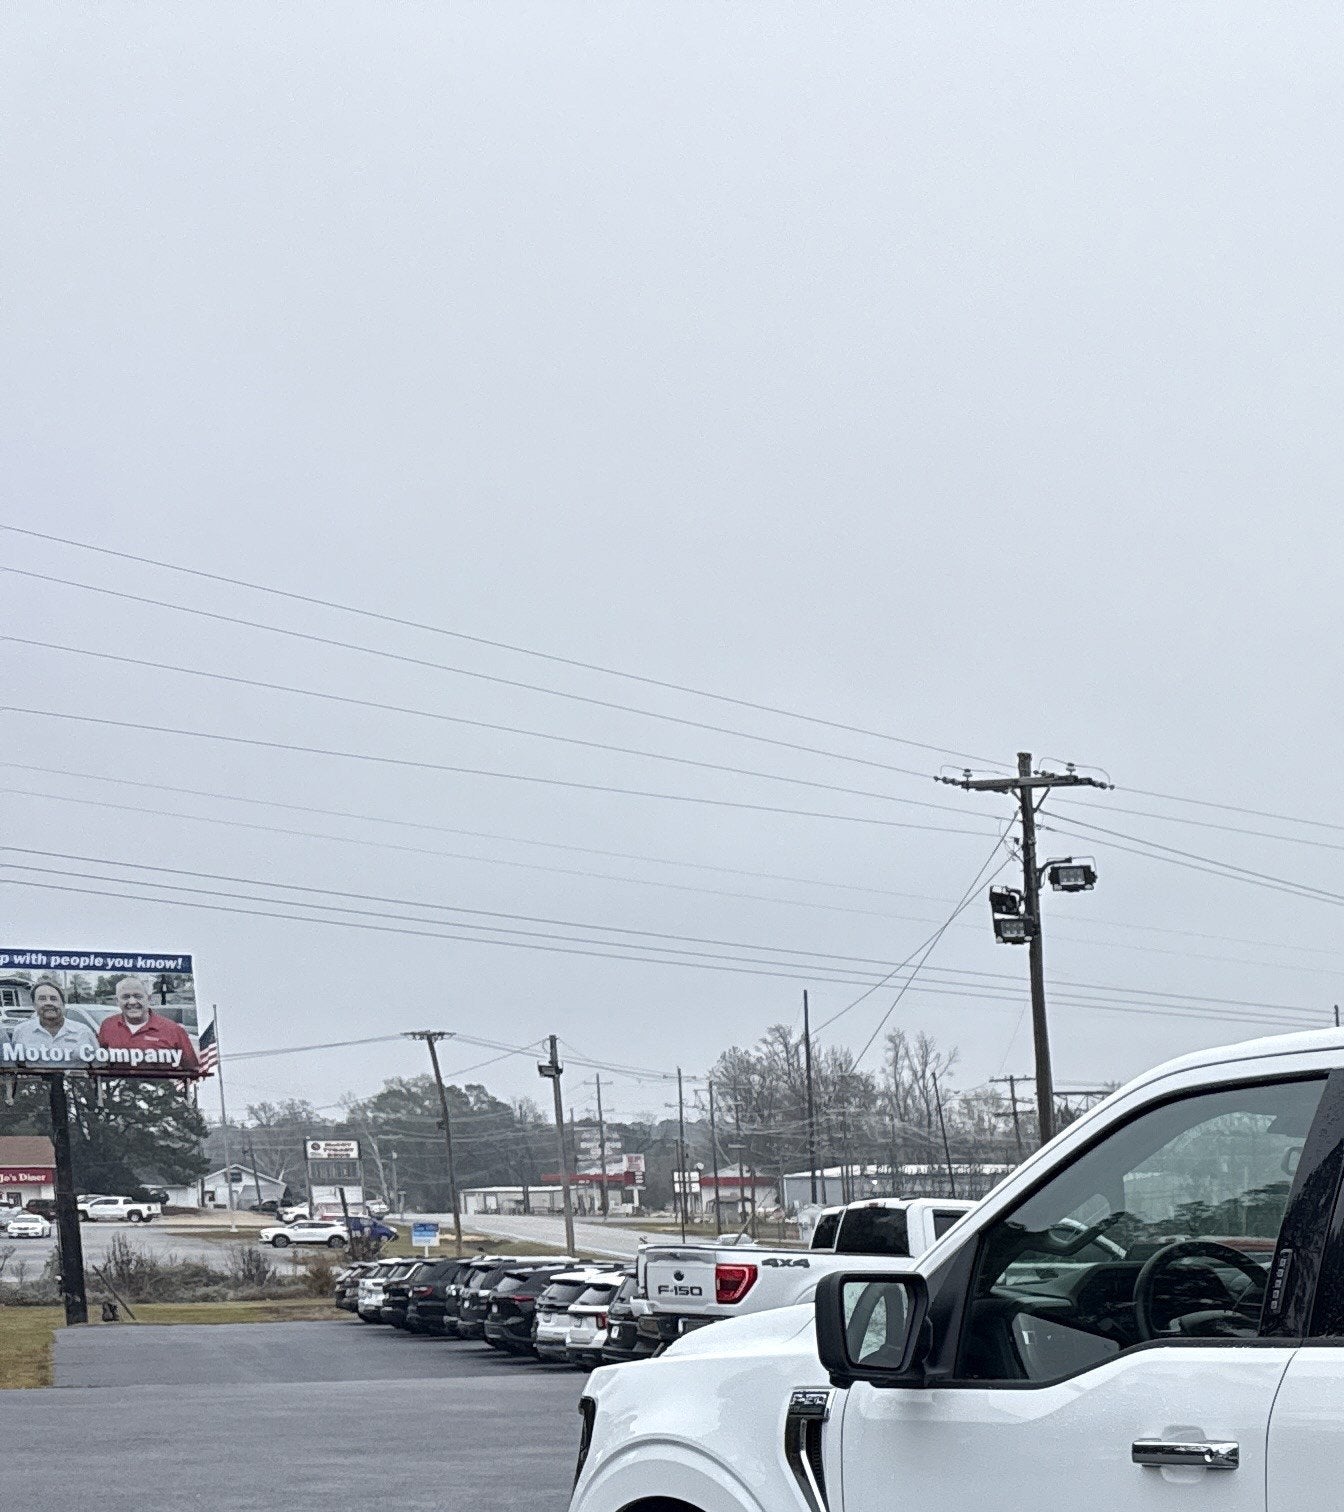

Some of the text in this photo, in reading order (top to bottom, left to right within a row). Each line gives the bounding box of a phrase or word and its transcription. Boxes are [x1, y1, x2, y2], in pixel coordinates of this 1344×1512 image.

[13, 952, 47, 966] with
[50, 954, 104, 968] people
[105, 957, 133, 969] you
[136, 957, 183, 970] know!
[2, 1043, 183, 1067] Motor Company
[658, 1284, 703, 1296] F-150
